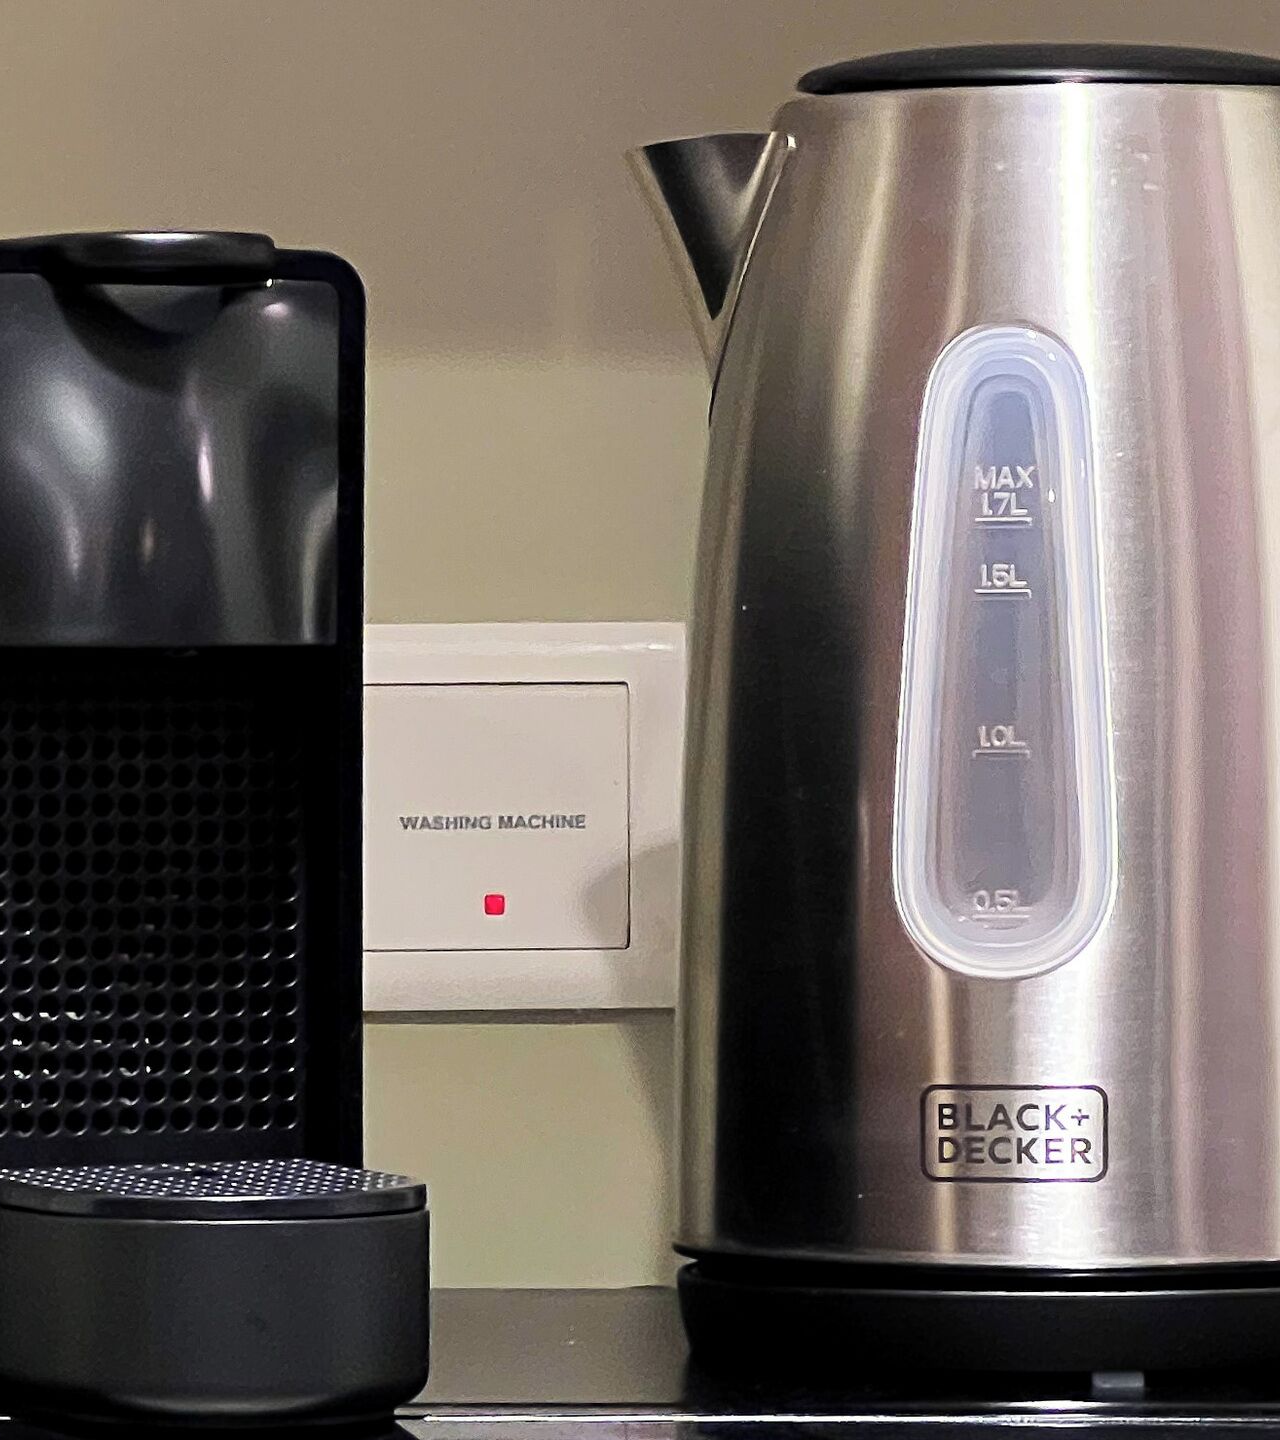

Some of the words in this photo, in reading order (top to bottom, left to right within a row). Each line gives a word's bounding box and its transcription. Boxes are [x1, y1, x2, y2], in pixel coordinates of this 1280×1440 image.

[974, 465, 1035, 490] MAX
[982, 491, 1028, 516] 1.7L
[399, 815, 492, 830] WASHING
[498, 814, 586, 829] MACHINE
[938, 1103, 1090, 1131] BLACK+
[938, 1136, 1092, 1164] DECKER
